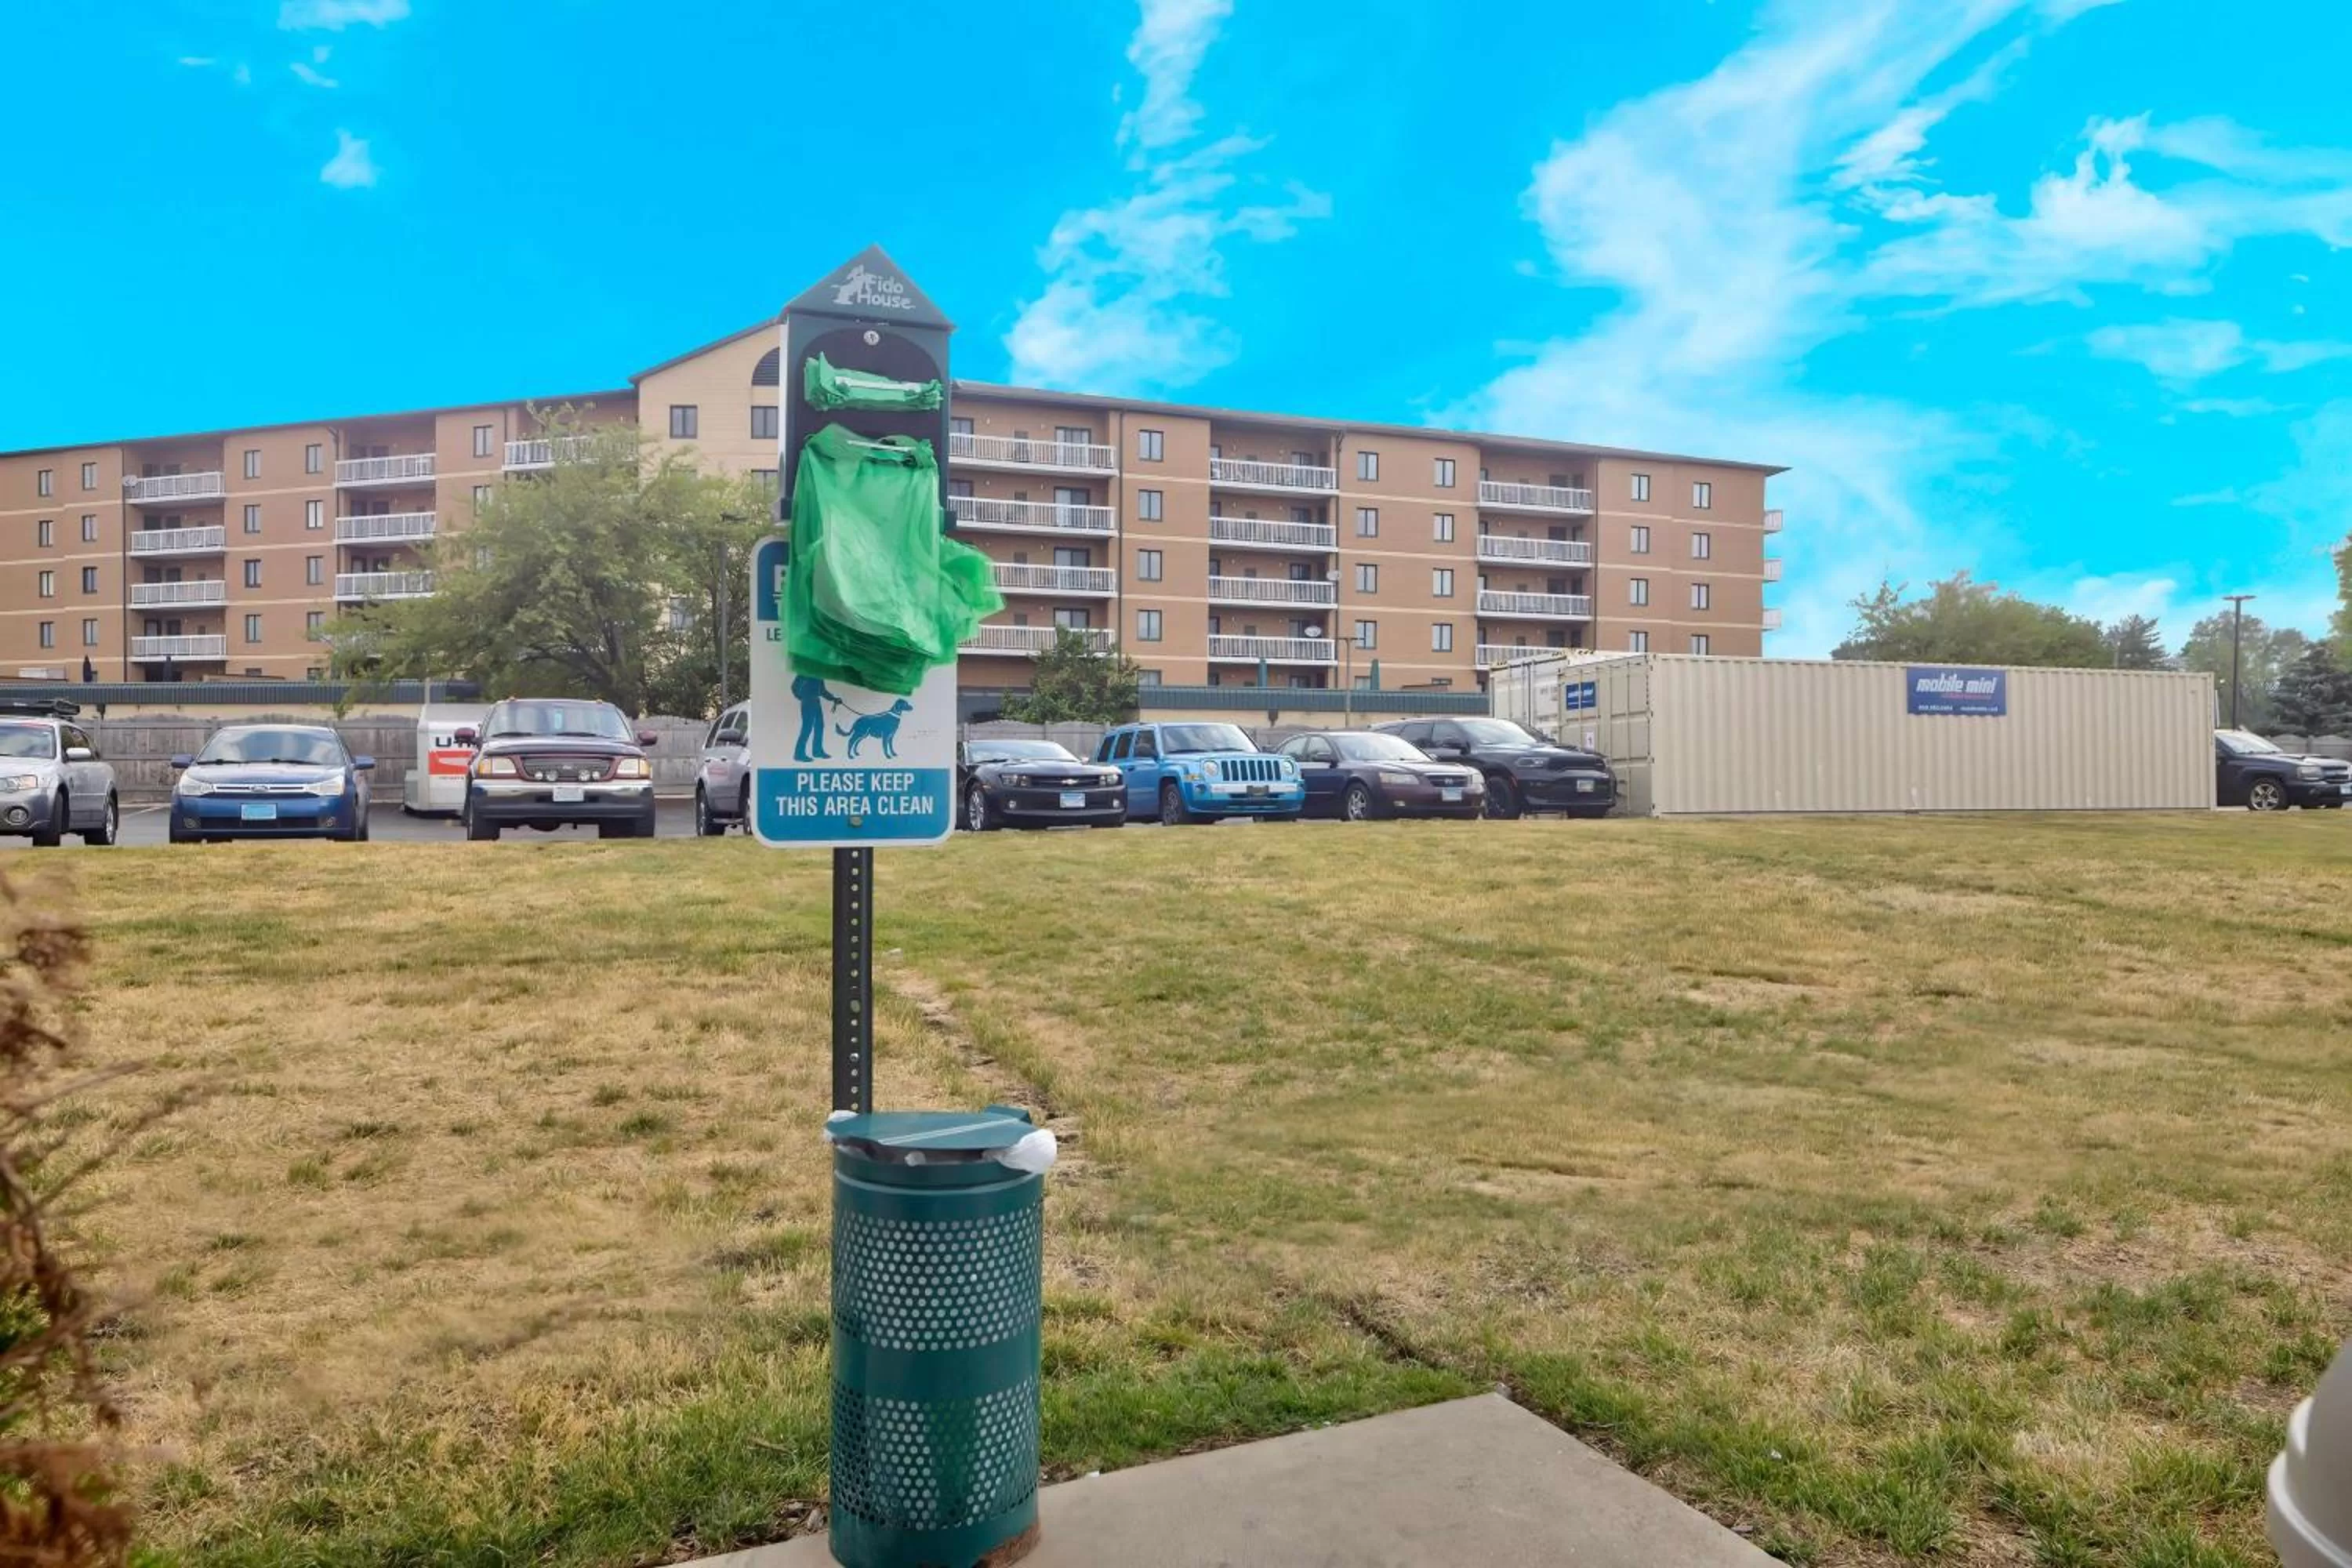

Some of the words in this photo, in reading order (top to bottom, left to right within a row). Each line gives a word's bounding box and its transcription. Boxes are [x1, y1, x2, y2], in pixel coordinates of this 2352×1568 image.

[864, 273, 904, 294] Fido
[857, 288, 916, 310] House
[1915, 672, 1964, 692] mobile
[1965, 677, 1998, 694] mini
[797, 771, 865, 793] PLEASE
[870, 771, 915, 793] KEEP
[775, 796, 818, 817] THIS
[824, 795, 872, 817] AREA
[877, 795, 934, 815] CLEAN
